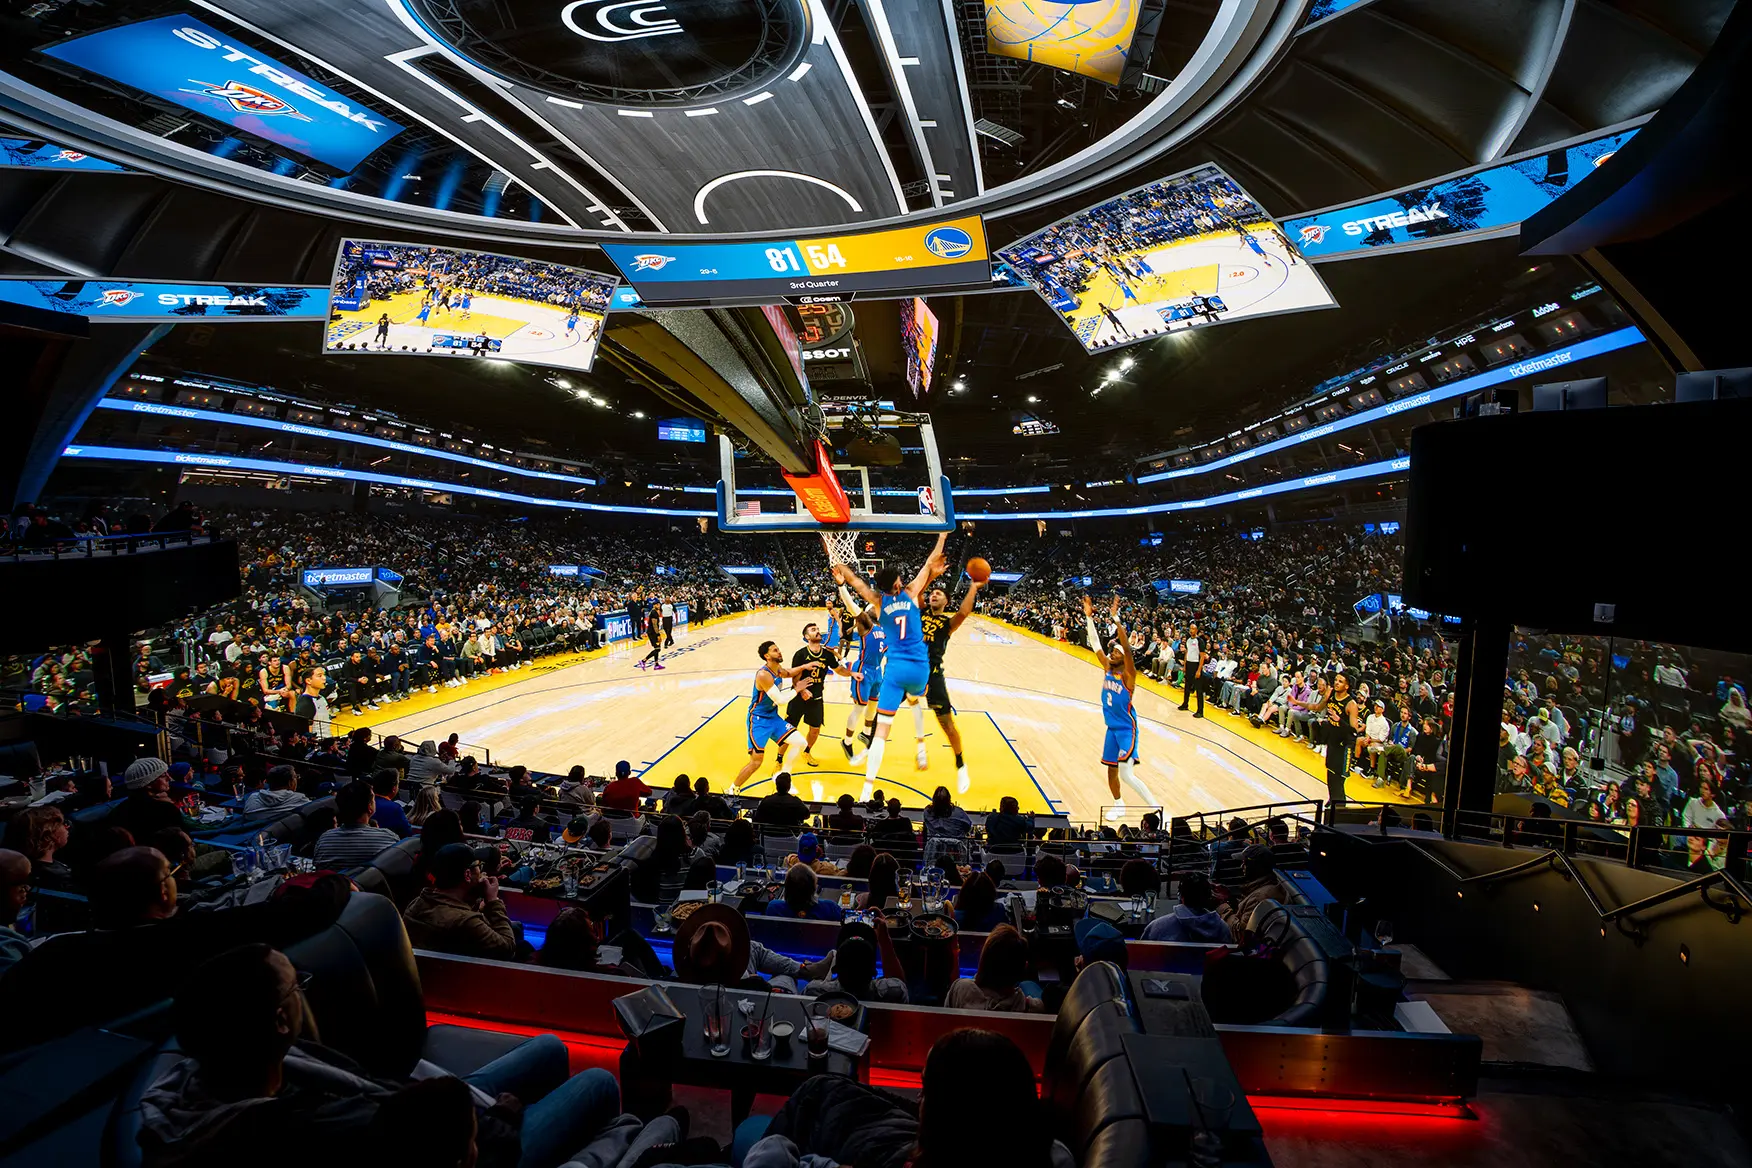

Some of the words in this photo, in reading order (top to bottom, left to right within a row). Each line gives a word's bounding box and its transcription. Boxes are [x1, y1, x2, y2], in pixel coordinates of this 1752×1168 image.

[172, 27, 387, 133] STREAK
[1342, 202, 1449, 235] STREAK
[764, 247, 800, 272] 81
[808, 243, 847, 268] 54
[790, 281, 806, 290] 3rd
[808, 279, 839, 289] Quarter
[157, 293, 268, 306] STREAK
[1532, 301, 1560, 318] Adobe
[1492, 320, 1515, 332] verizon
[1454, 335, 1476, 347] HPE
[802, 348, 850, 360] SSOT
[1386, 362, 1409, 375] ORACLE
[1509, 352, 1572, 377] ticketmaster
[133, 403, 198, 417] ticketmaster
[1385, 393, 1431, 414] ticketmaster
[282, 423, 330, 437] ticketmaster
[1300, 425, 1334, 440] ticketmaster
[390, 442, 426, 454] ticketmaster
[175, 455, 232, 465] ticketmaster
[1391, 459, 1410, 469] ticket
[304, 467, 346, 477] ticketmaster
[1304, 474, 1336, 486] ticketmaster
[307, 571, 370, 583] ticketmaster
[612, 619, 633, 637] Pick'E
[895, 615, 907, 640] 7
[922, 622, 937, 636] 32
